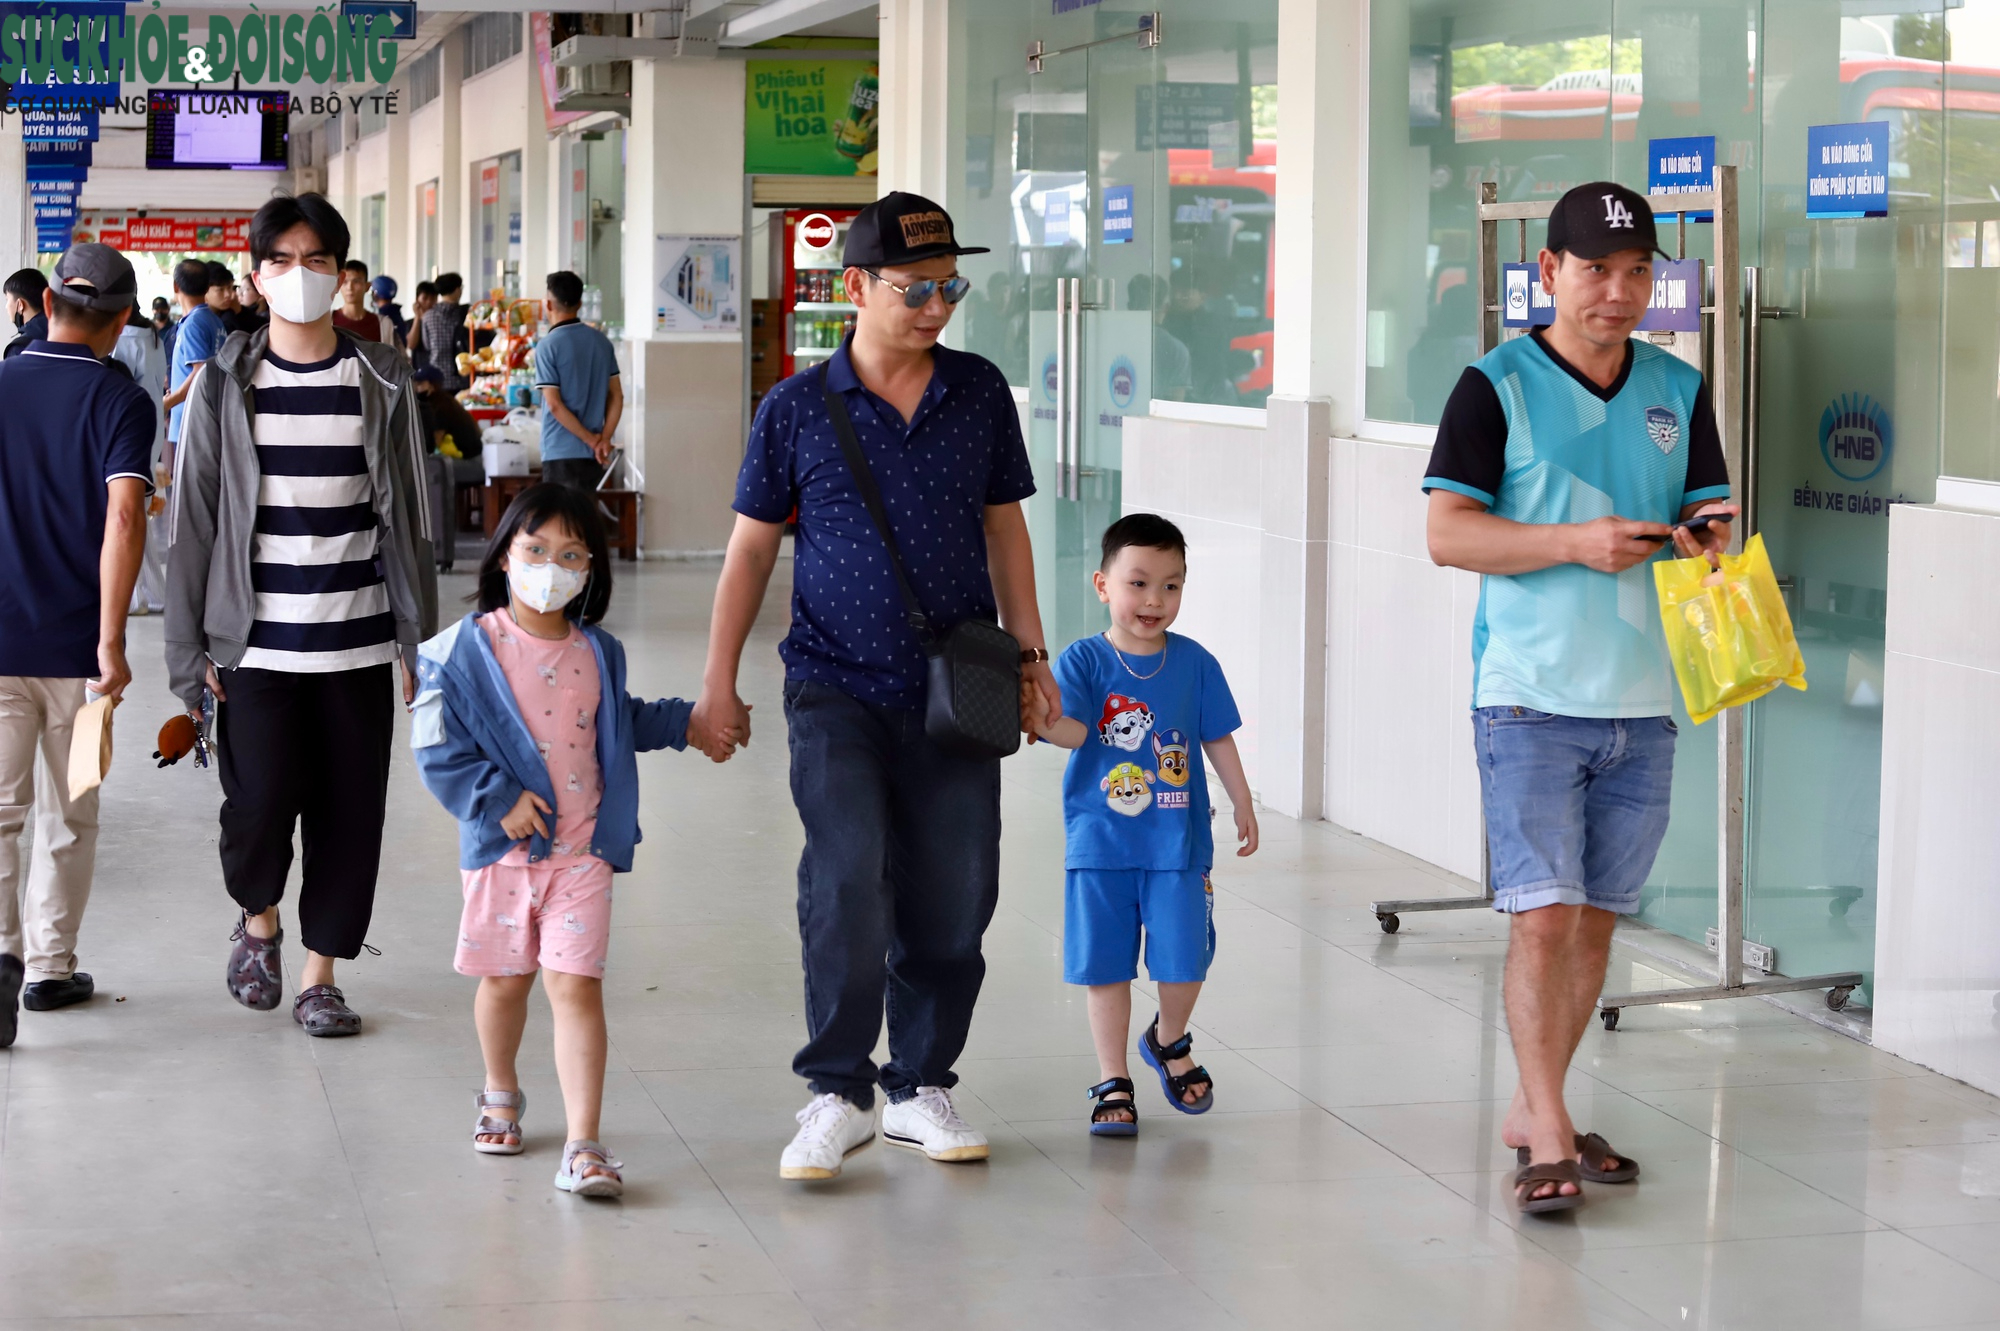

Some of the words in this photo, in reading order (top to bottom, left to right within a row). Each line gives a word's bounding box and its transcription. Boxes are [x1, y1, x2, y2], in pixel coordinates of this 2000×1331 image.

[755, 70, 807, 89] Phiêu
[22, 123, 54, 136] UYÊN
[1822, 146, 1830, 164] RA
[1831, 142, 1843, 164] VÀO
[1843, 141, 1860, 163] ĐÓNG
[1860, 137, 1873, 162] CỬA
[1810, 174, 1829, 196] KHÔNG
[1830, 173, 1846, 199] PHẬN
[1847, 174, 1856, 199] SỰ
[1873, 171, 1885, 194] VÀO
[1601, 194, 1634, 228] LA
[1667, 279, 1686, 314] ĐỊNH
[1834, 434, 1875, 461] HNB
[1793, 479, 1822, 509] BẾN
[1825, 492, 1844, 511] XE
[1847, 489, 1881, 516] GIÁP
